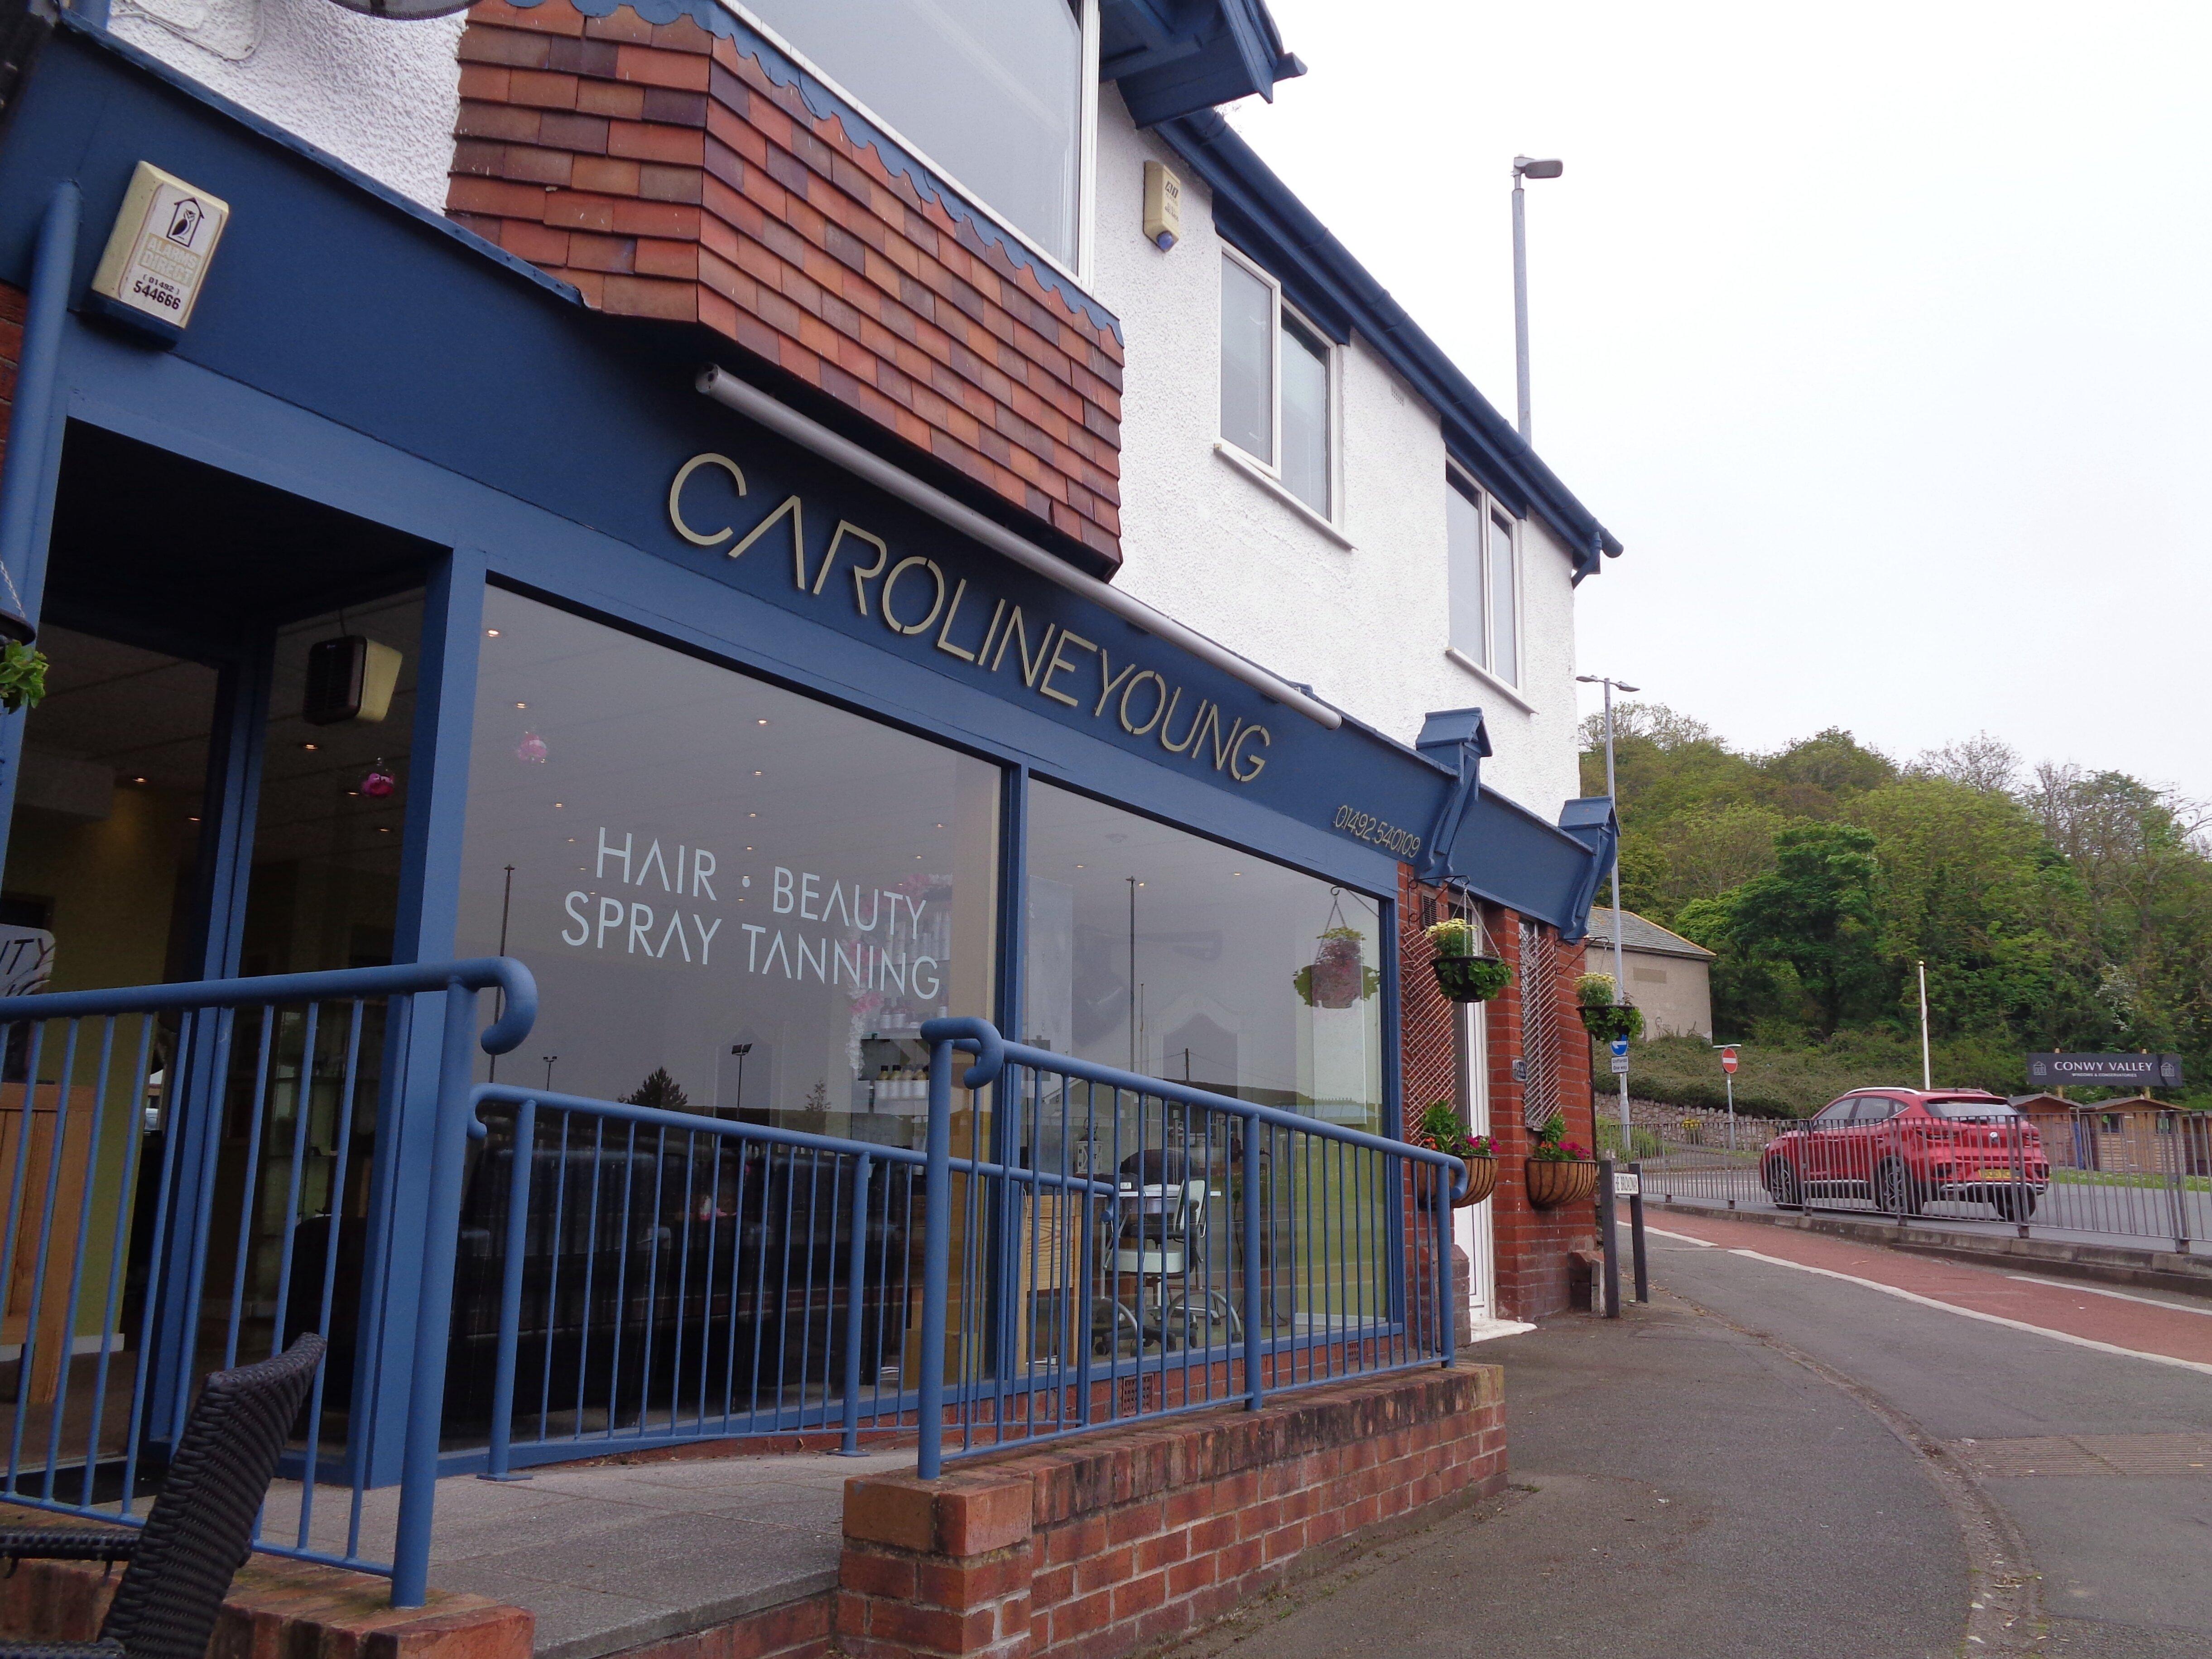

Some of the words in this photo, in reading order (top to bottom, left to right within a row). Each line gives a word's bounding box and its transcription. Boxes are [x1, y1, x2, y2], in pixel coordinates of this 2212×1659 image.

[140, 251, 195, 284] DIRECT
[147, 237, 197, 269] ALARMS
[133, 280, 181, 309] 544666
[596, 827, 717, 901] HAIR
[773, 866, 927, 940] BEAUTY
[562, 891, 722, 965] SPRAY
[741, 923, 940, 999] TANNING
[2054, 1061, 2104, 1071] CONWY
[2108, 1062, 2153, 1071] VALLEY
